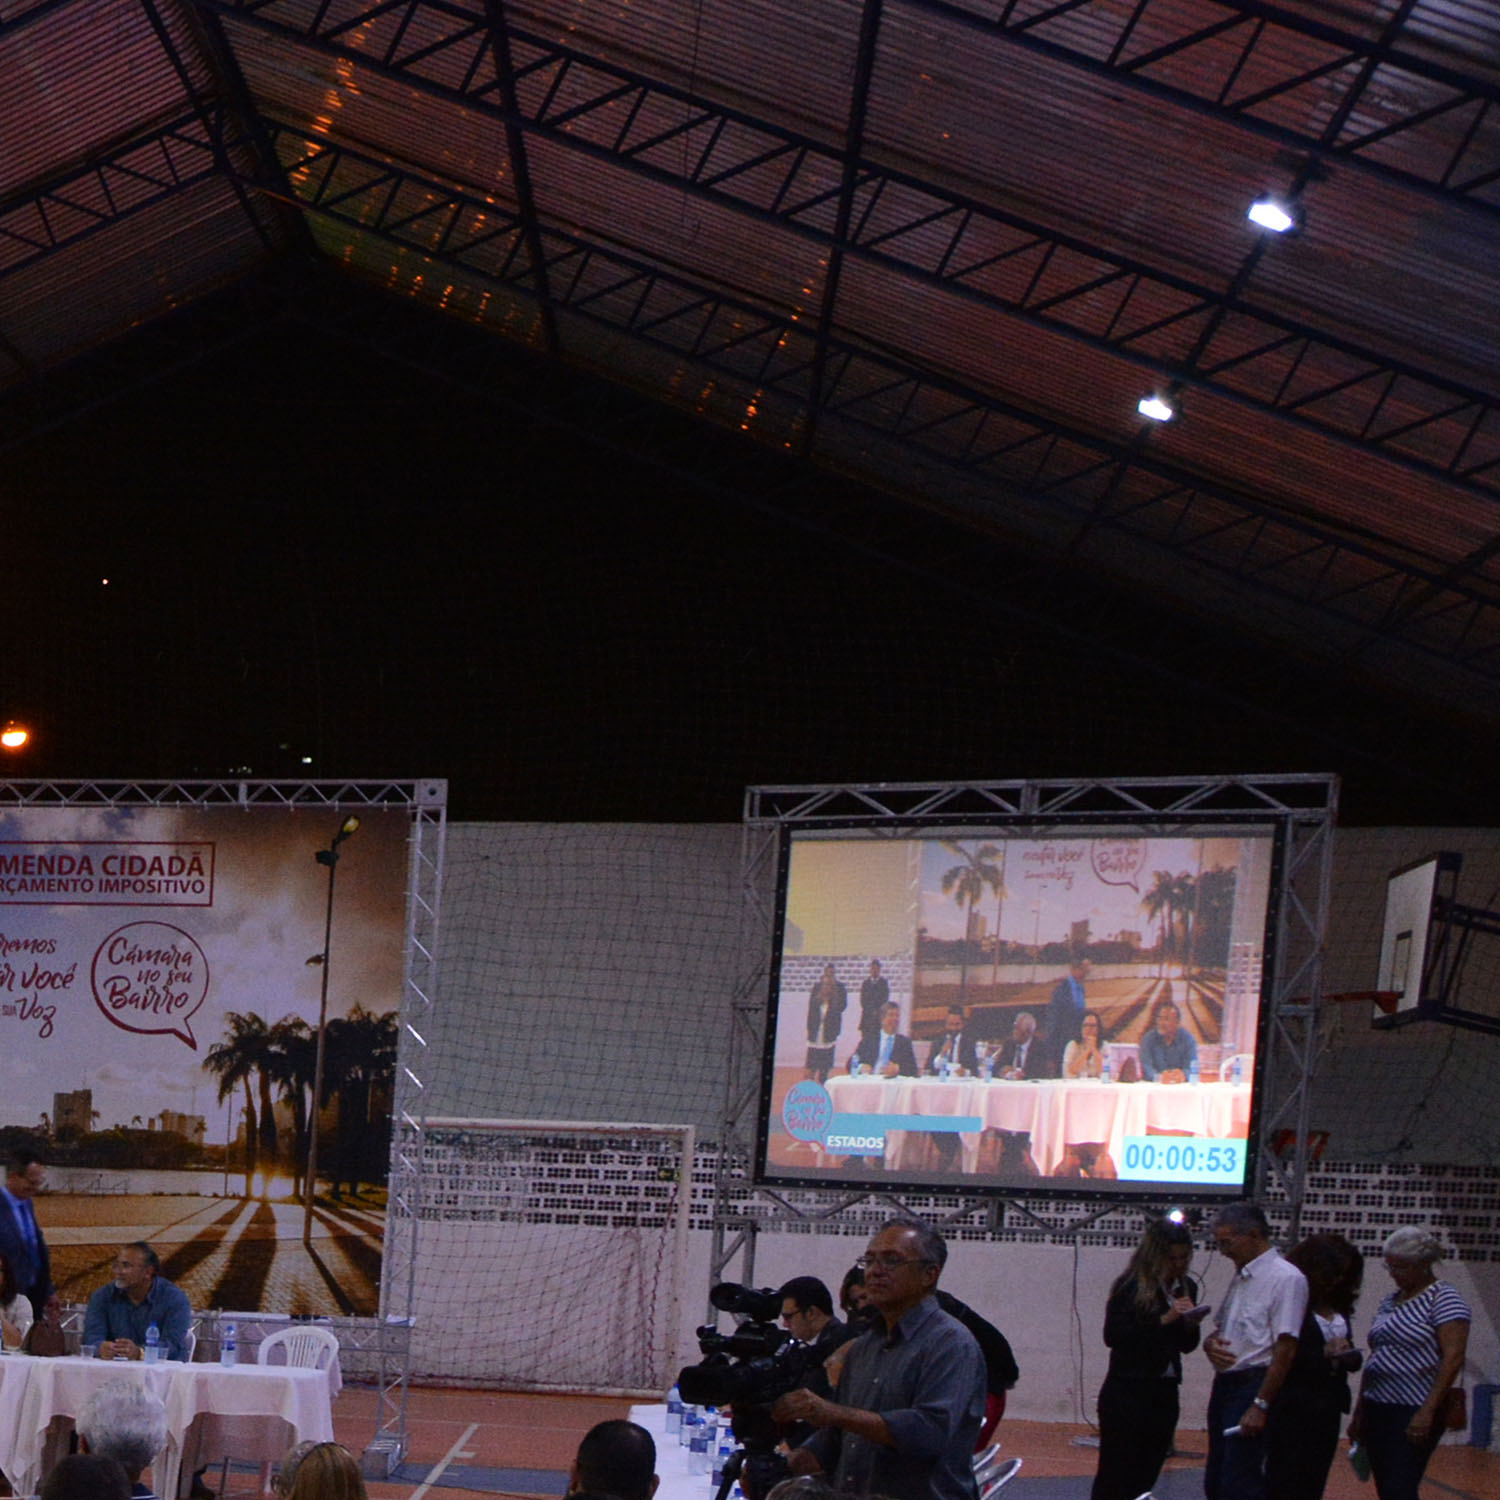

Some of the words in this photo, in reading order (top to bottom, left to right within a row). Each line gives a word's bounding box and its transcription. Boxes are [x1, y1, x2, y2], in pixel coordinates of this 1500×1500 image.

[102, 851, 204, 877] CIDADÃ
[99, 879, 205, 895] IMPOSITIVO
[137, 969, 161, 984] no
[166, 969, 192, 985] seu
[103, 975, 189, 1014] Bairro
[15, 992, 56, 1038] Voz
[827, 1135, 885, 1149] ESTADOS
[1126, 1144, 1237, 1173] 00:00:53
